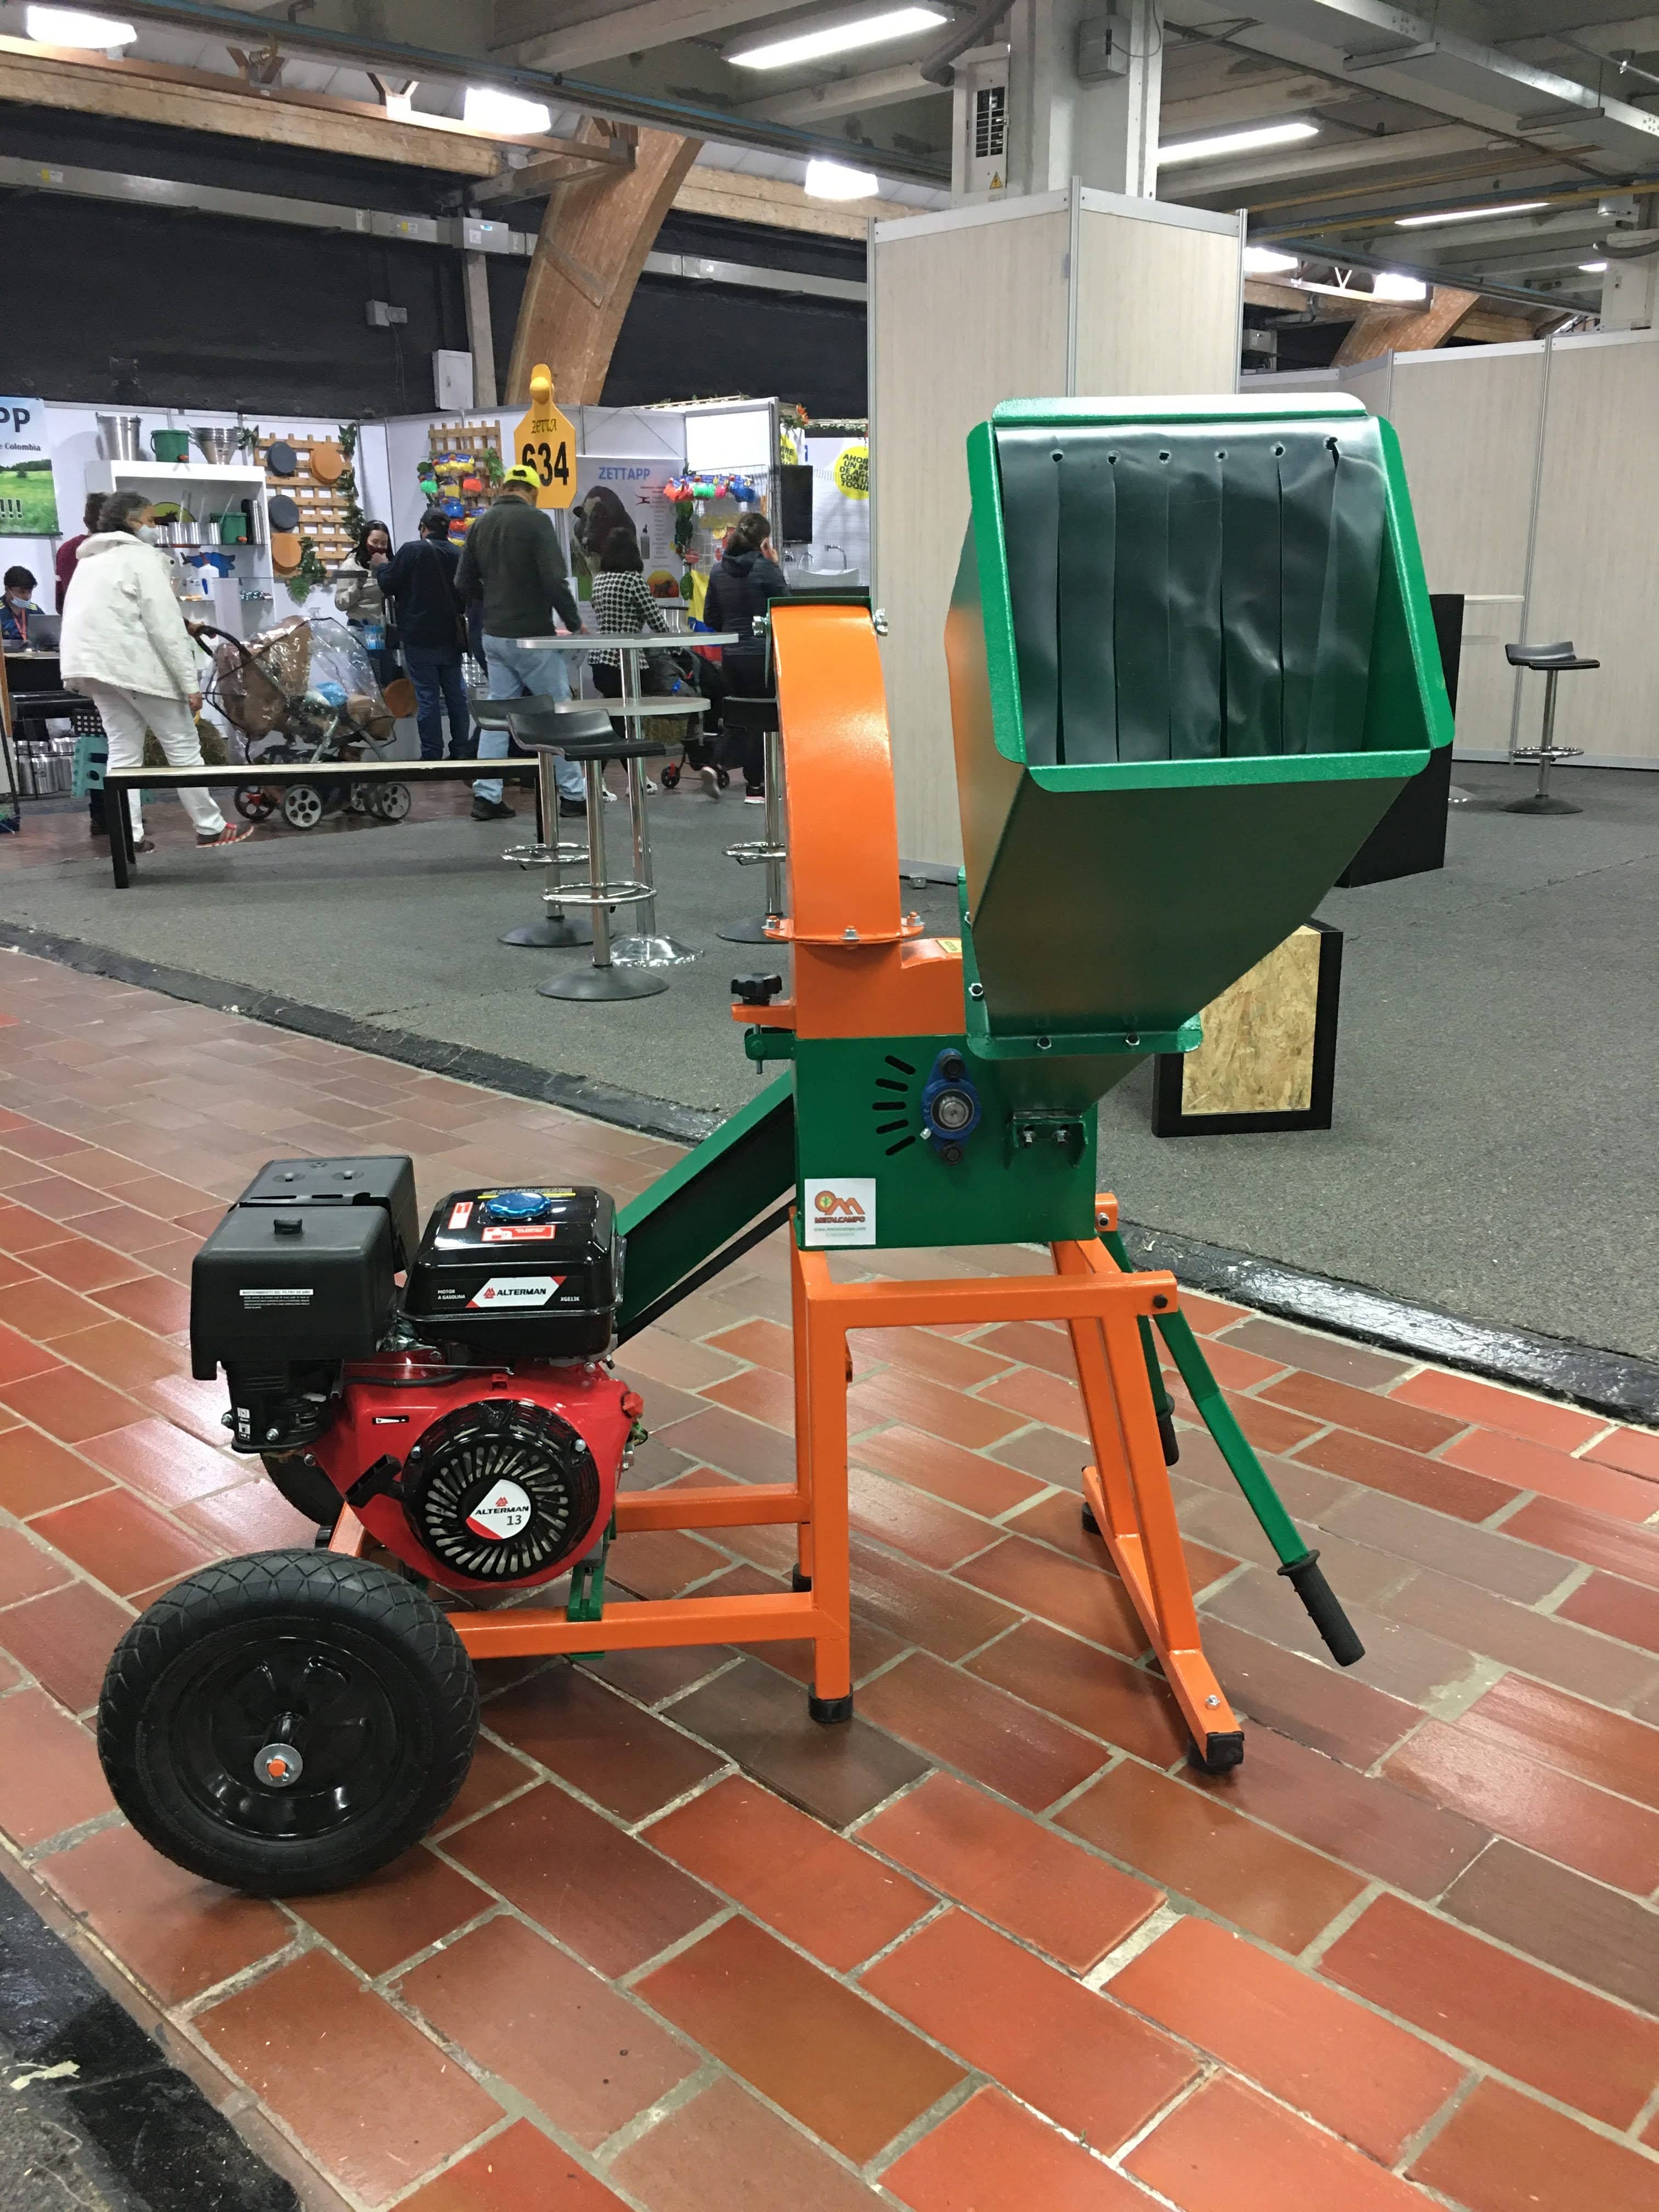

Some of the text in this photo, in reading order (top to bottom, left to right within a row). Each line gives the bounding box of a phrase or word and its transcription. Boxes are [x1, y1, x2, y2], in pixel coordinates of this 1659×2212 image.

[531, 419, 557, 434] ZETTA
[4, 443, 41, 451] Colombia
[598, 467, 650, 480] ZETTAPP
[839, 466, 851, 474] DE
[840, 473, 859, 483] CON
[475, 1506, 529, 1515] ALTERMAN
[506, 1515, 522, 1526] 13
